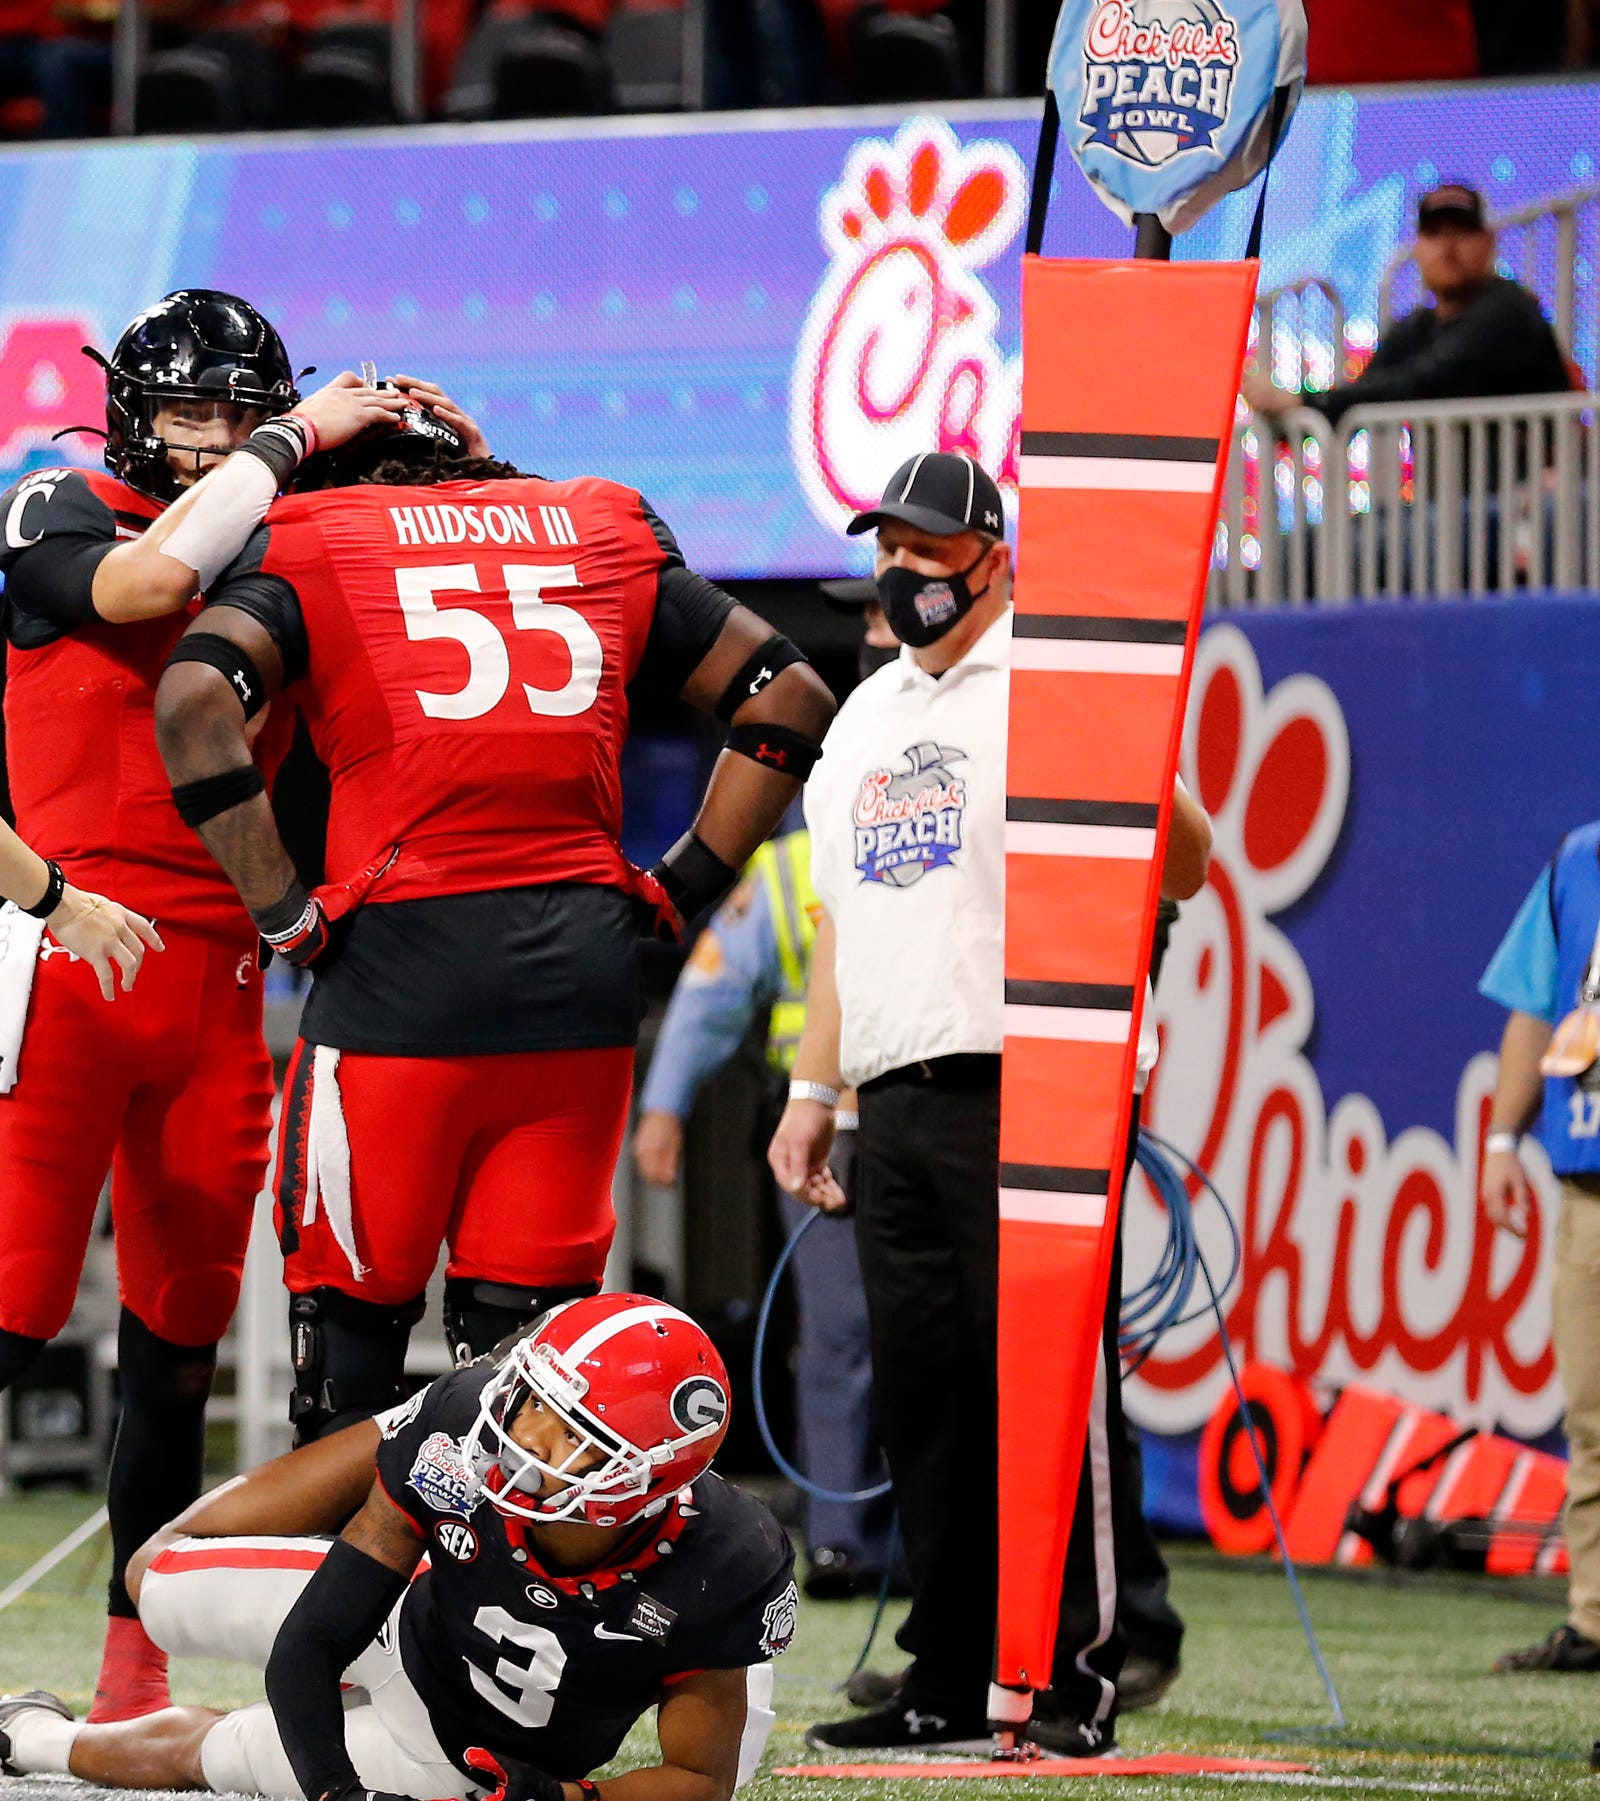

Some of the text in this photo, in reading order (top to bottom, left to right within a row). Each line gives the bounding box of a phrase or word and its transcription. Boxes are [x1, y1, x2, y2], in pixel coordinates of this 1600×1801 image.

[1088, 0, 1232, 66] Chck-fil-A
[1082, 64, 1231, 119] PEACH
[1107, 108, 1195, 133] BOWL
[388, 504, 580, 547] HUDSON III
[394, 562, 604, 721] 55
[855, 809, 962, 866] PEACH
[874, 845, 936, 872] BOWL
[414, 1459, 470, 1503] PEAC
[438, 1523, 475, 1561] SEC
[631, 1617, 666, 1637] EQUALITY
[636, 1602, 672, 1627] TOGETHER
[462, 1606, 568, 1728] 3
